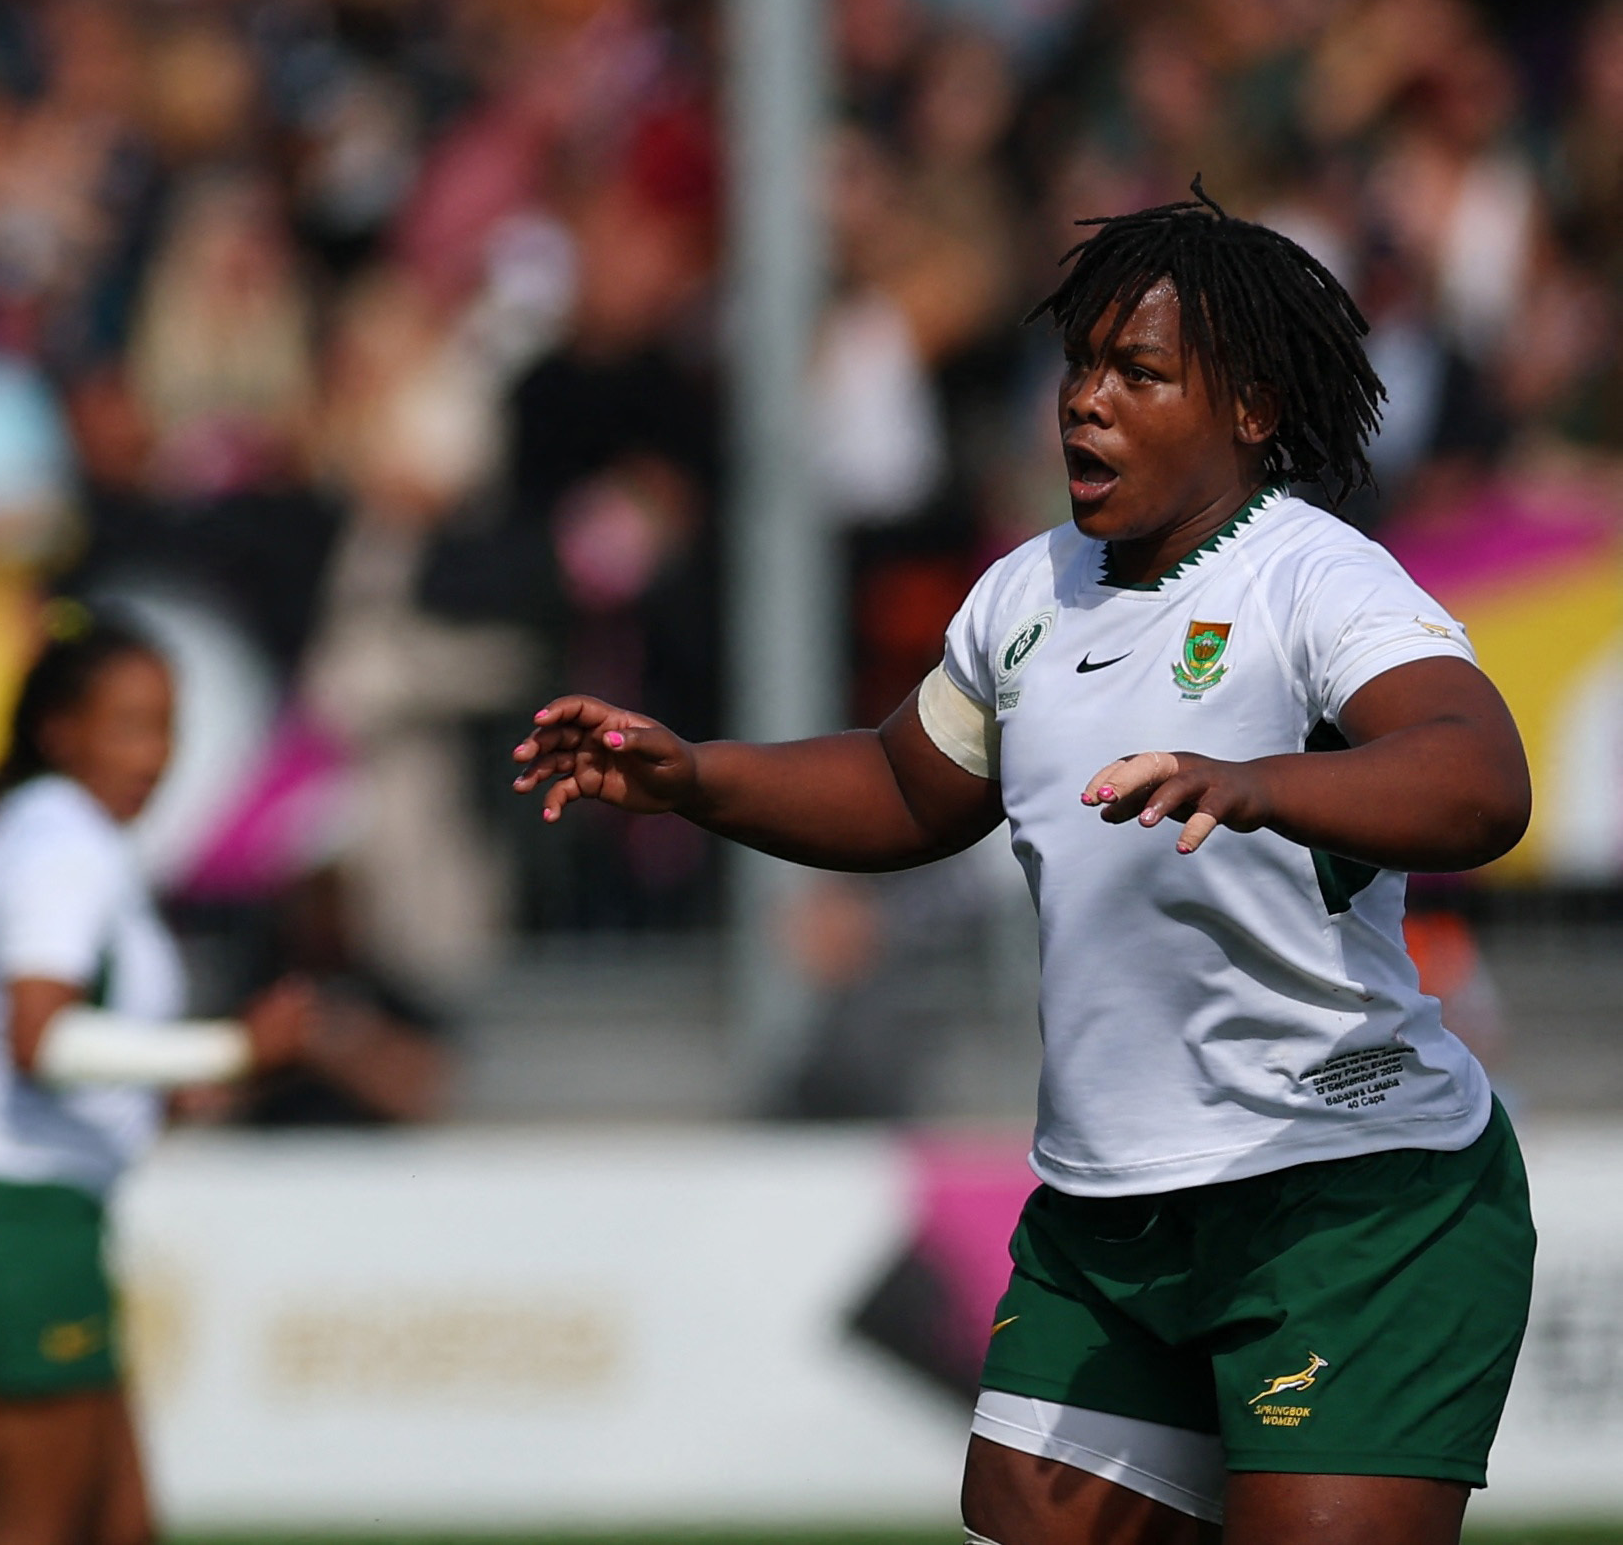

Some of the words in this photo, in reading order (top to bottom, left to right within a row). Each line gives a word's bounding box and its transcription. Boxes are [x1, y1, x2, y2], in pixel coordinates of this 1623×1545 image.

[1312, 1072, 1343, 1086] Sandy
[1371, 1055, 1402, 1069] Exeter
[1327, 1074, 1378, 1092] September
[1380, 1063, 1404, 1077] 2025
[1347, 1098, 1360, 1111] 40
[1360, 1092, 1386, 1106] Caps
[1254, 1404, 1312, 1417] SPRINGBOK
[1262, 1415, 1301, 1427] WOMEN
